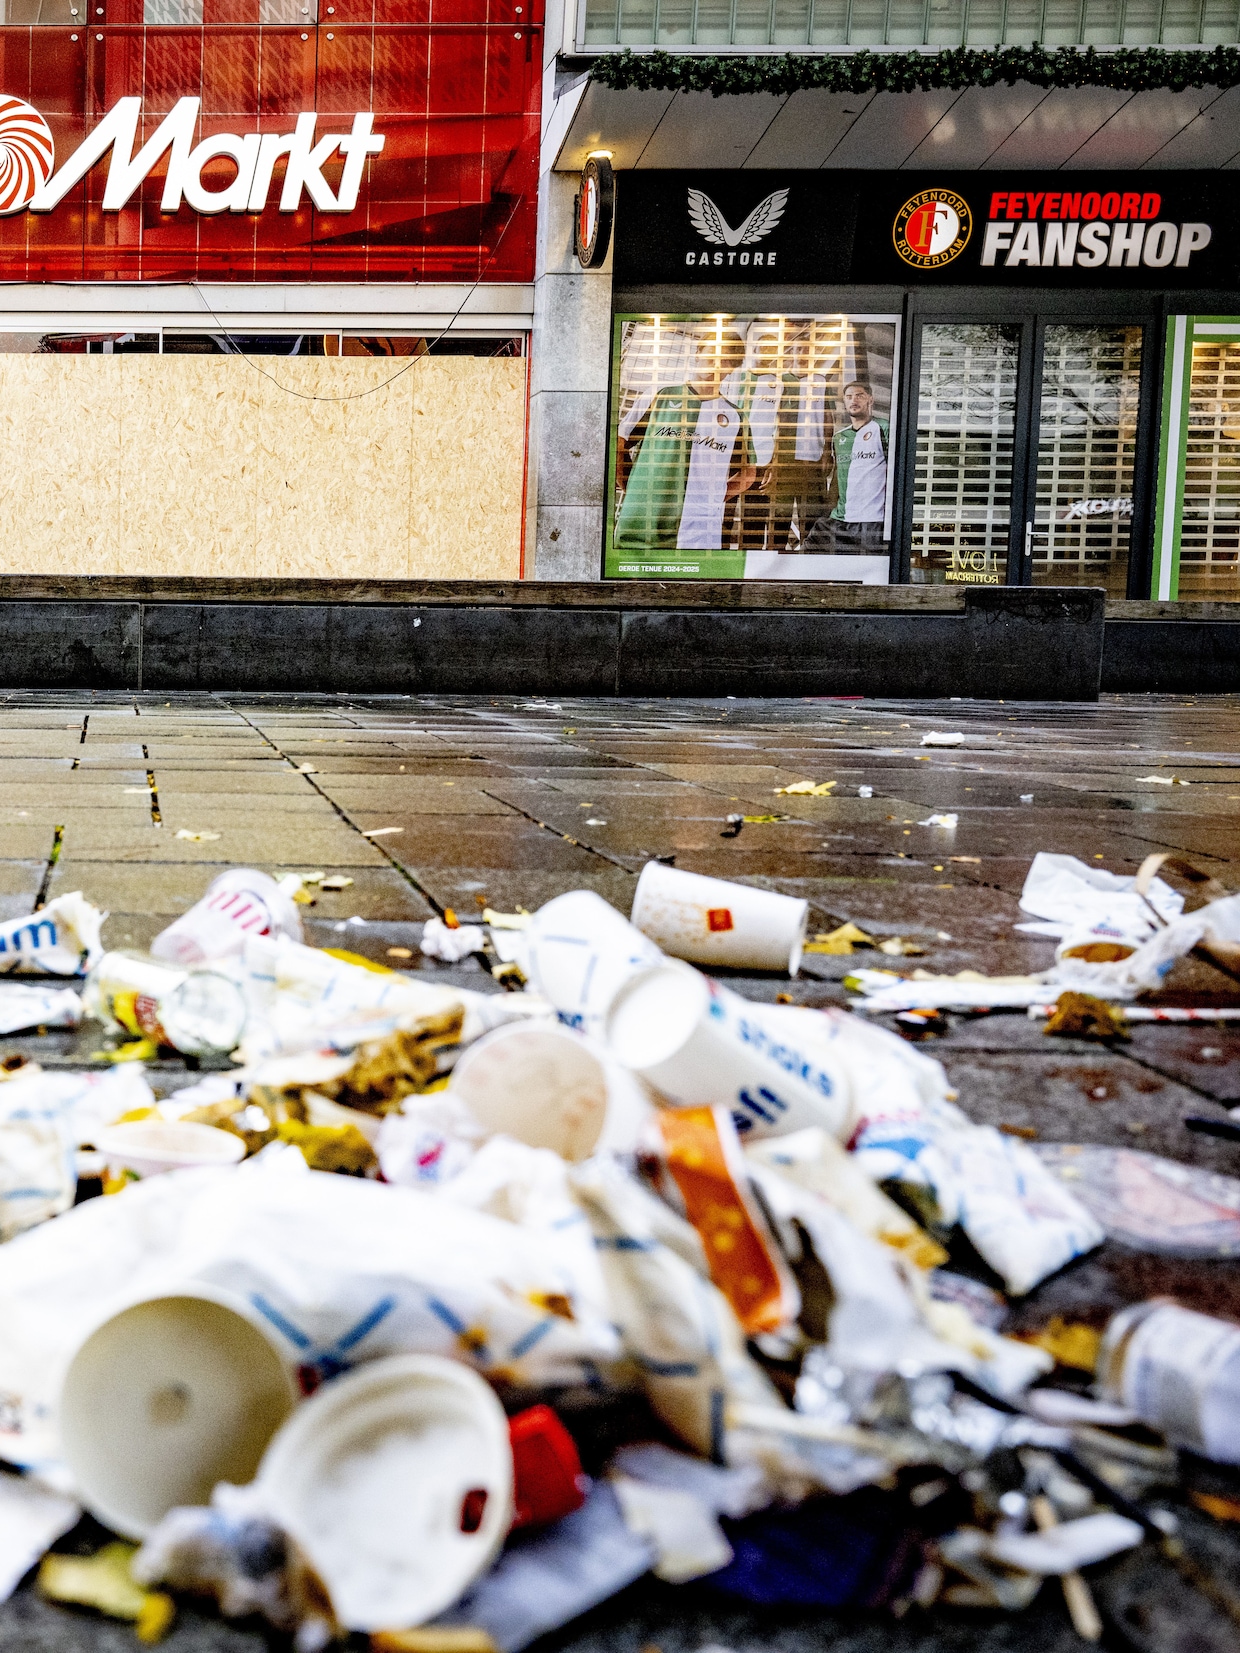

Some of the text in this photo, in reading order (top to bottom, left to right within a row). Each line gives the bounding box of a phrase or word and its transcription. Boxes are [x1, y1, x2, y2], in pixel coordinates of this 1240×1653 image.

[25, 96, 385, 213] Markt
[900, 191, 967, 219] FEYENOORD
[988, 191, 1162, 219] FEYENOORD
[897, 237, 965, 266] ROTTERDAM
[979, 221, 1212, 268] FANSHOP
[685, 251, 777, 267] CASTORE
[641, 565, 662, 573] TENUE
[663, 565, 700, 573] 2024-2025
